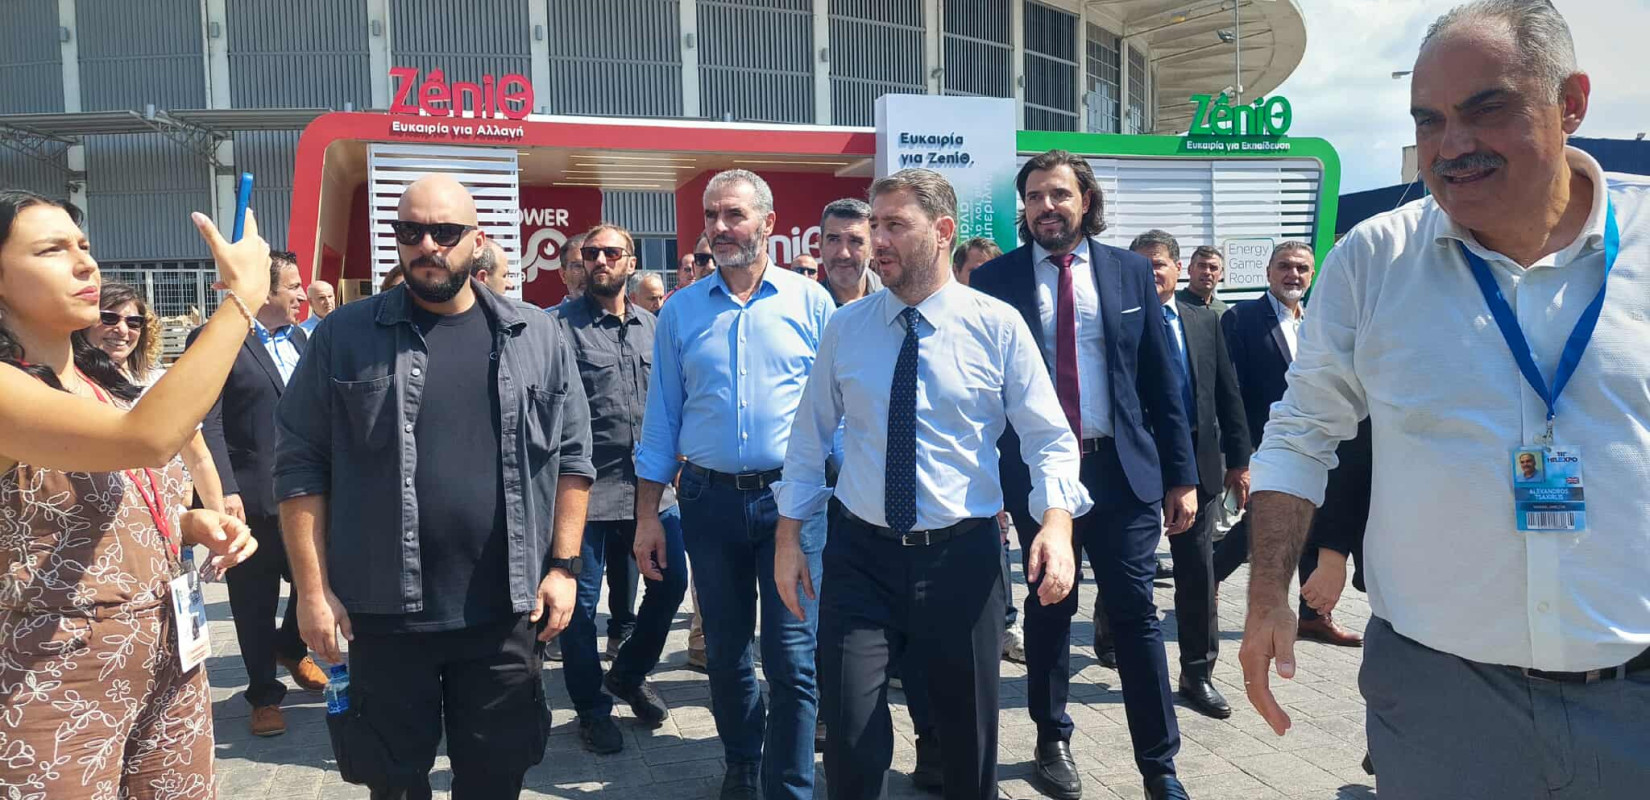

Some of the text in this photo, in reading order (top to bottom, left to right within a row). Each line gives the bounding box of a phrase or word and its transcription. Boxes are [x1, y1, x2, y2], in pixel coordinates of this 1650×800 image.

[392, 121, 524, 138] Ευκαιρία για Αλλαγή
[900, 132, 963, 147] Ευκαιρία
[1186, 140, 1225, 151] Ευκαιρία
[1226, 142, 1240, 152] για
[901, 153, 923, 165] για
[1229, 243, 1270, 257] Energy
[1229, 258, 1263, 269] Game
[1229, 272, 1265, 284] Room
